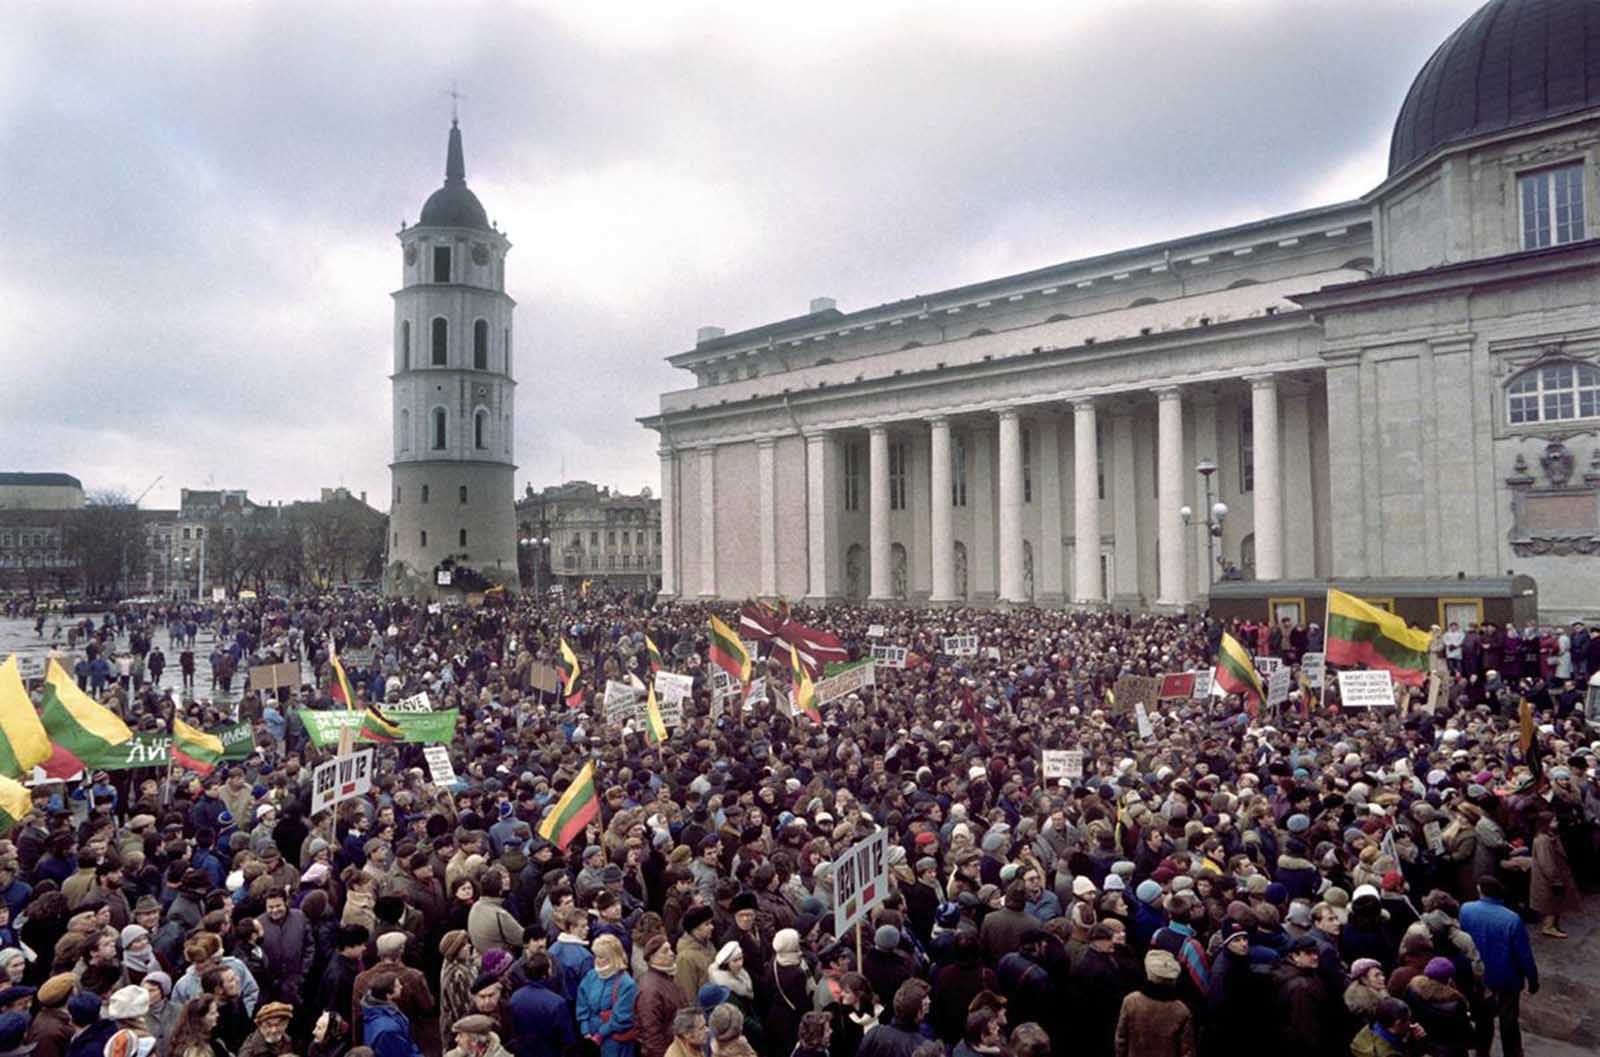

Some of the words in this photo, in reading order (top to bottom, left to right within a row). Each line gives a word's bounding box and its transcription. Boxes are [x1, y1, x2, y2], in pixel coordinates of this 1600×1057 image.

[356, 755, 367, 779] 12
[837, 856, 855, 907] 1920
[872, 840, 883, 878] 12
